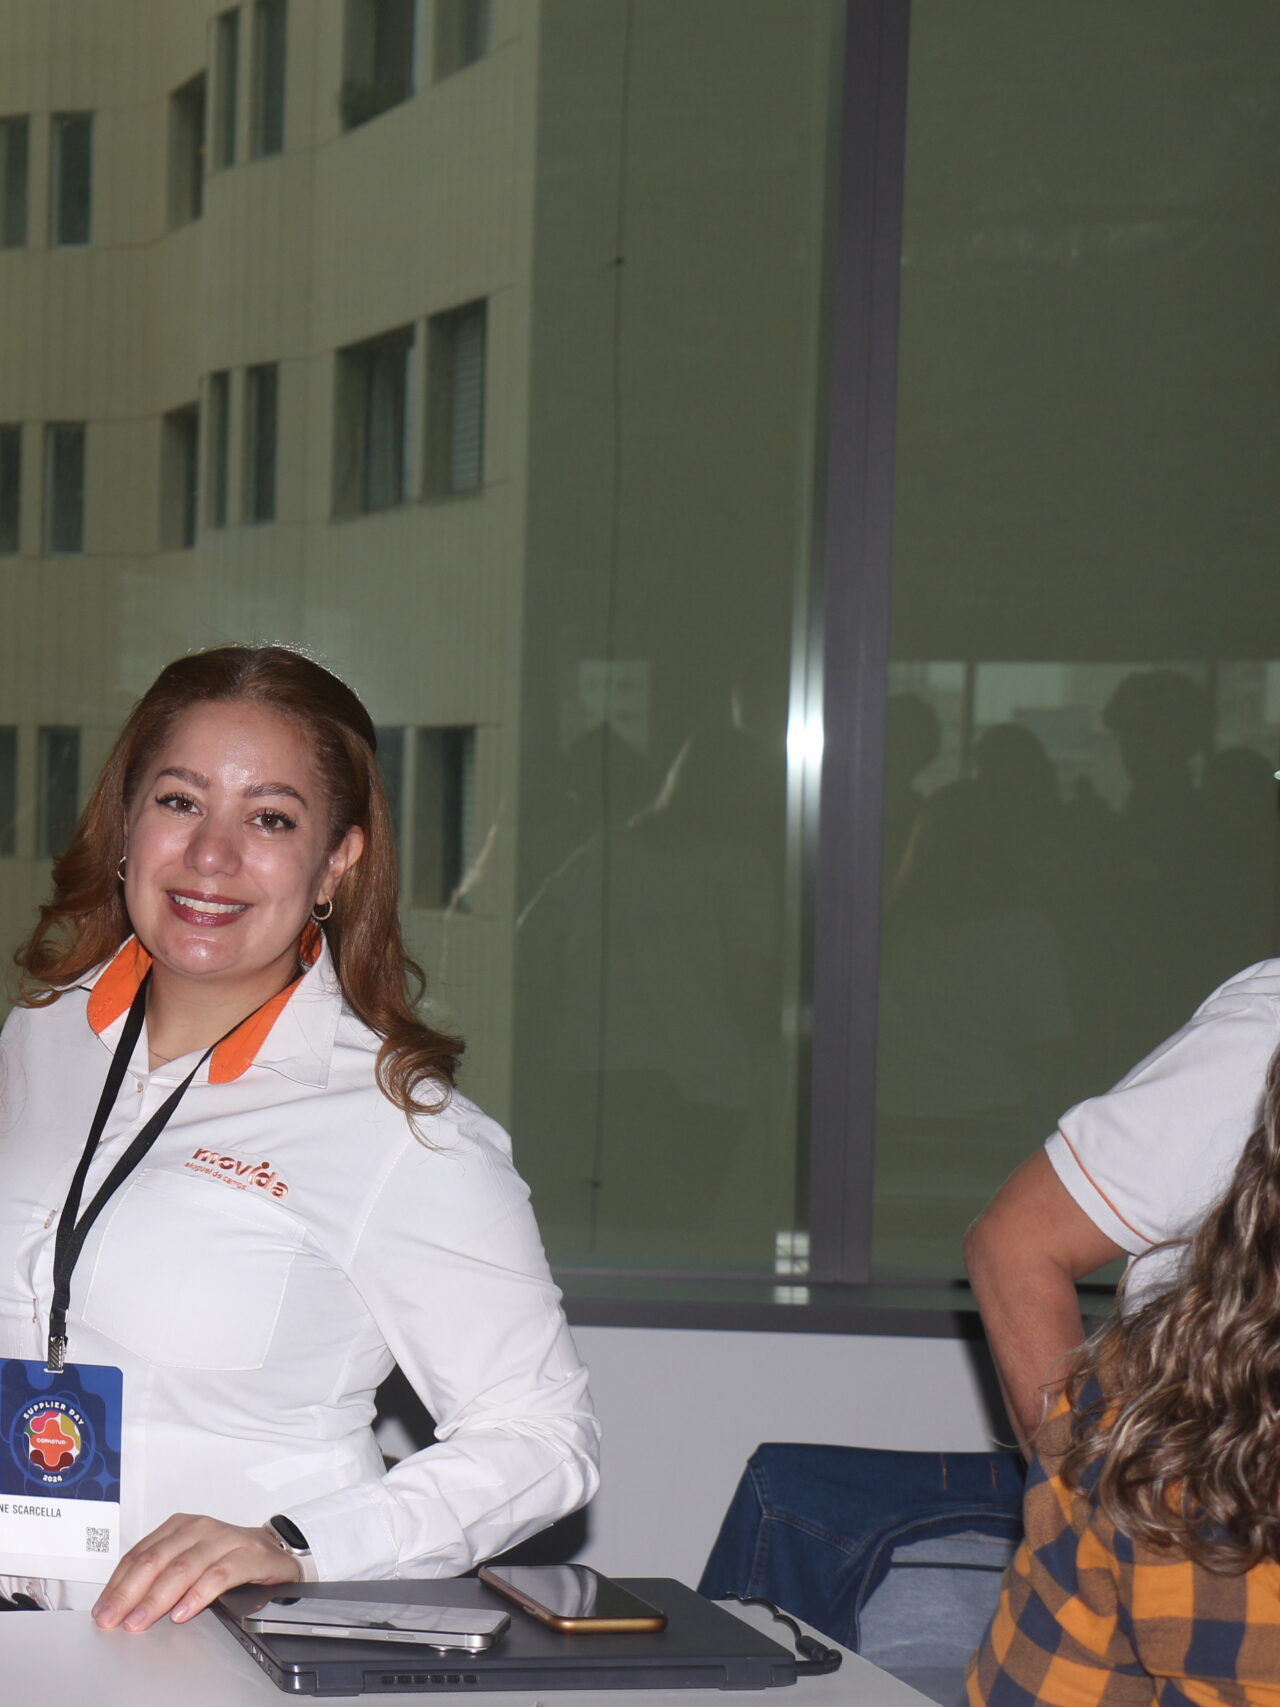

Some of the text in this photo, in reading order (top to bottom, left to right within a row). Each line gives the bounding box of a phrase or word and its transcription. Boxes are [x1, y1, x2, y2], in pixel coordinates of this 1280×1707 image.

[192, 1148, 289, 1200] movida
[23, 1401, 85, 1426] SUPPLIER DAY
[42, 1474, 63, 1483] 2024
[12, 1504, 61, 1518] SCARCELLA
